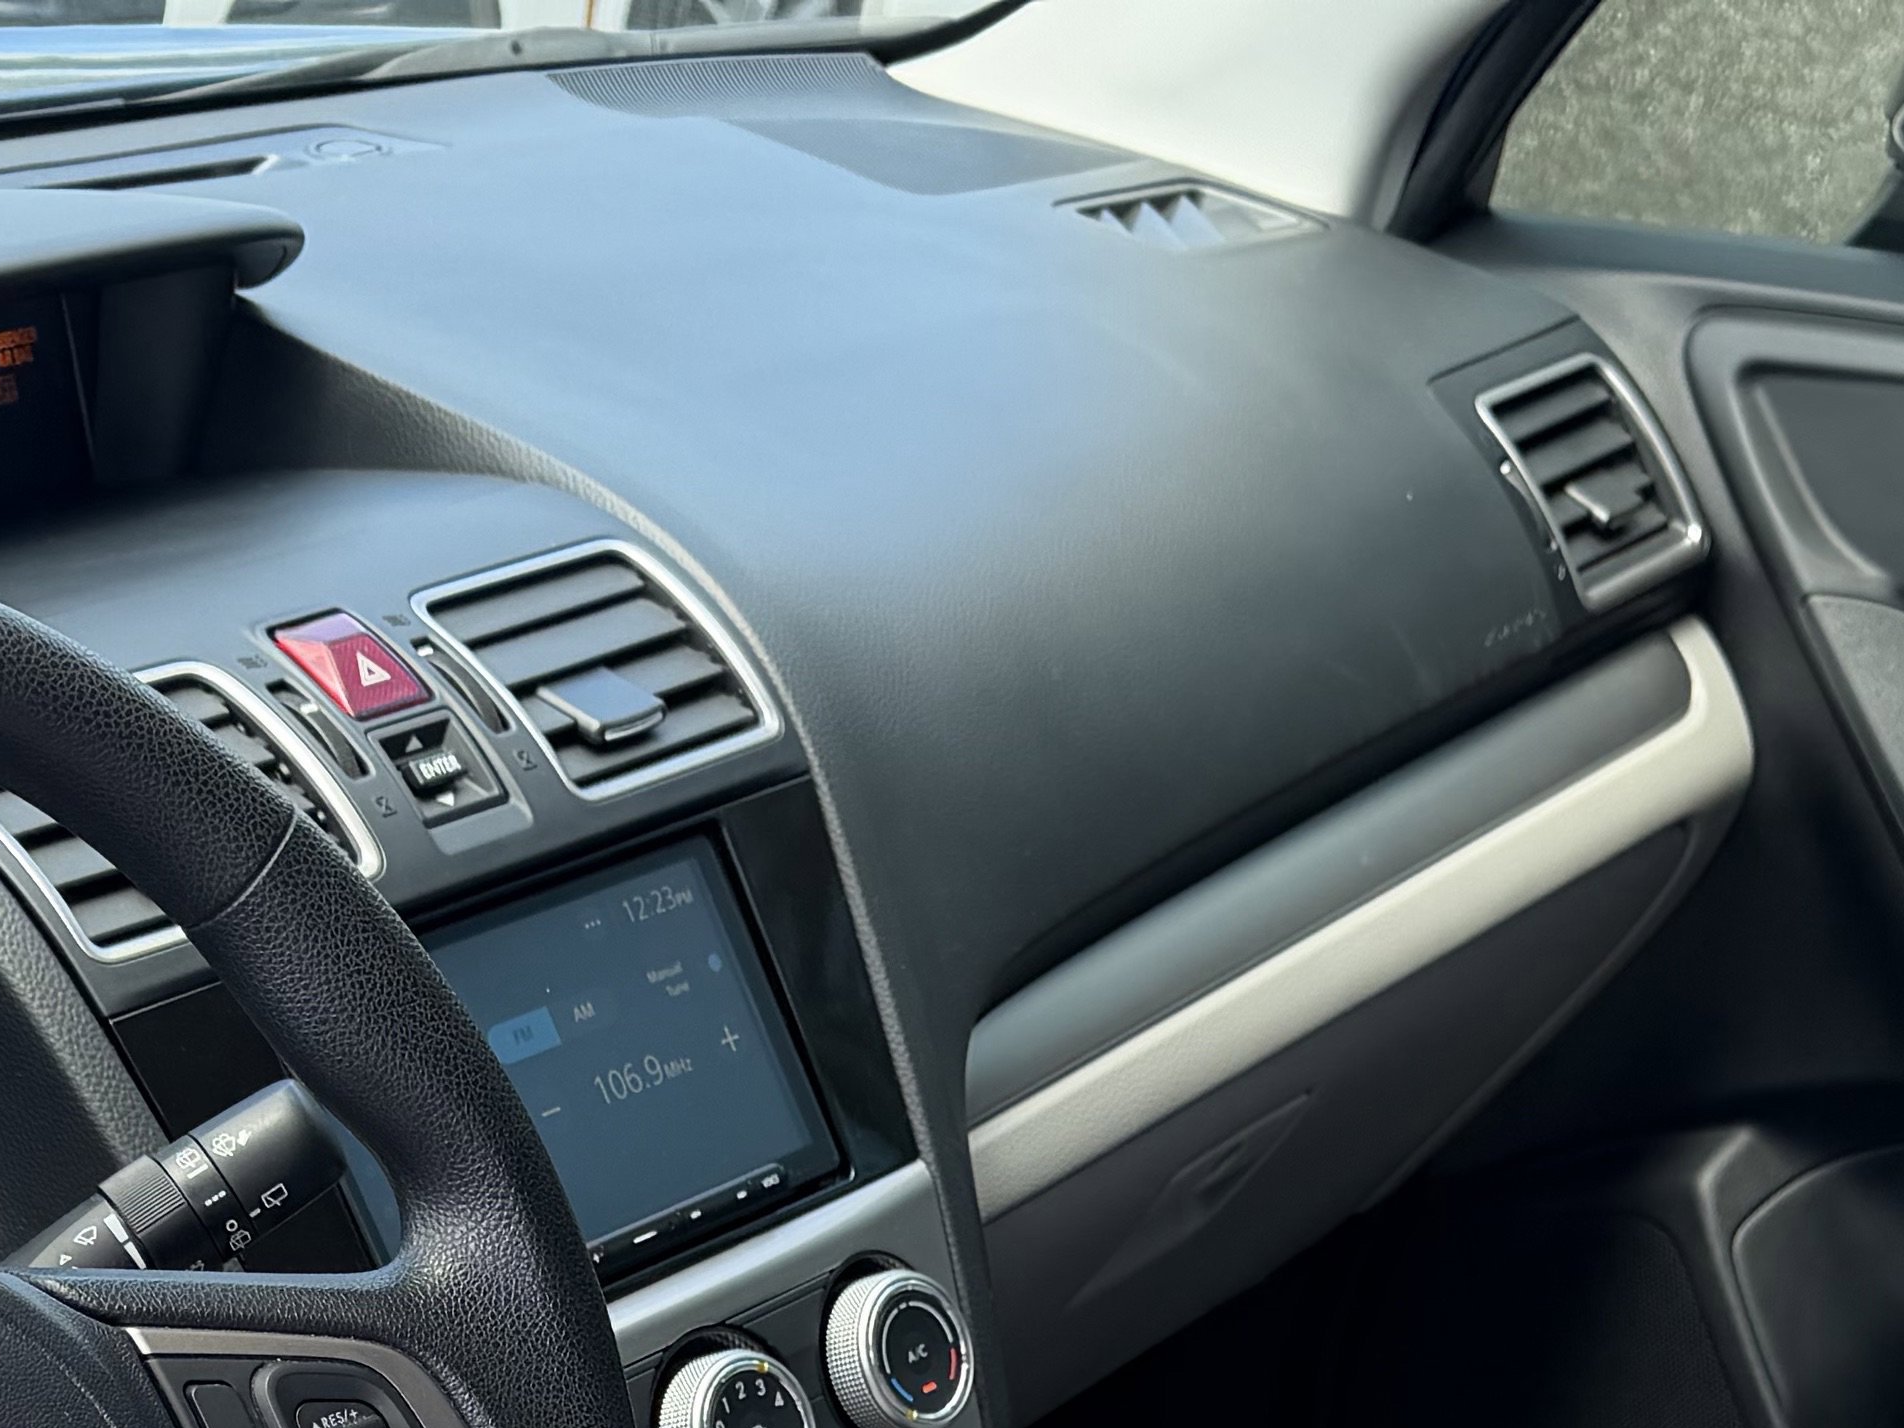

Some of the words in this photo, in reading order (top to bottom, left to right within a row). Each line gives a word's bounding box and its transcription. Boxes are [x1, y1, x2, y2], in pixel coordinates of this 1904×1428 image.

[419, 753, 463, 780] ENTER
[646, 960, 684, 984] Manual
[573, 1001, 596, 1023] AM
[908, 1343, 929, 1364] A/C
[736, 1381, 746, 1400] 2
[756, 1379, 767, 1397] 3
